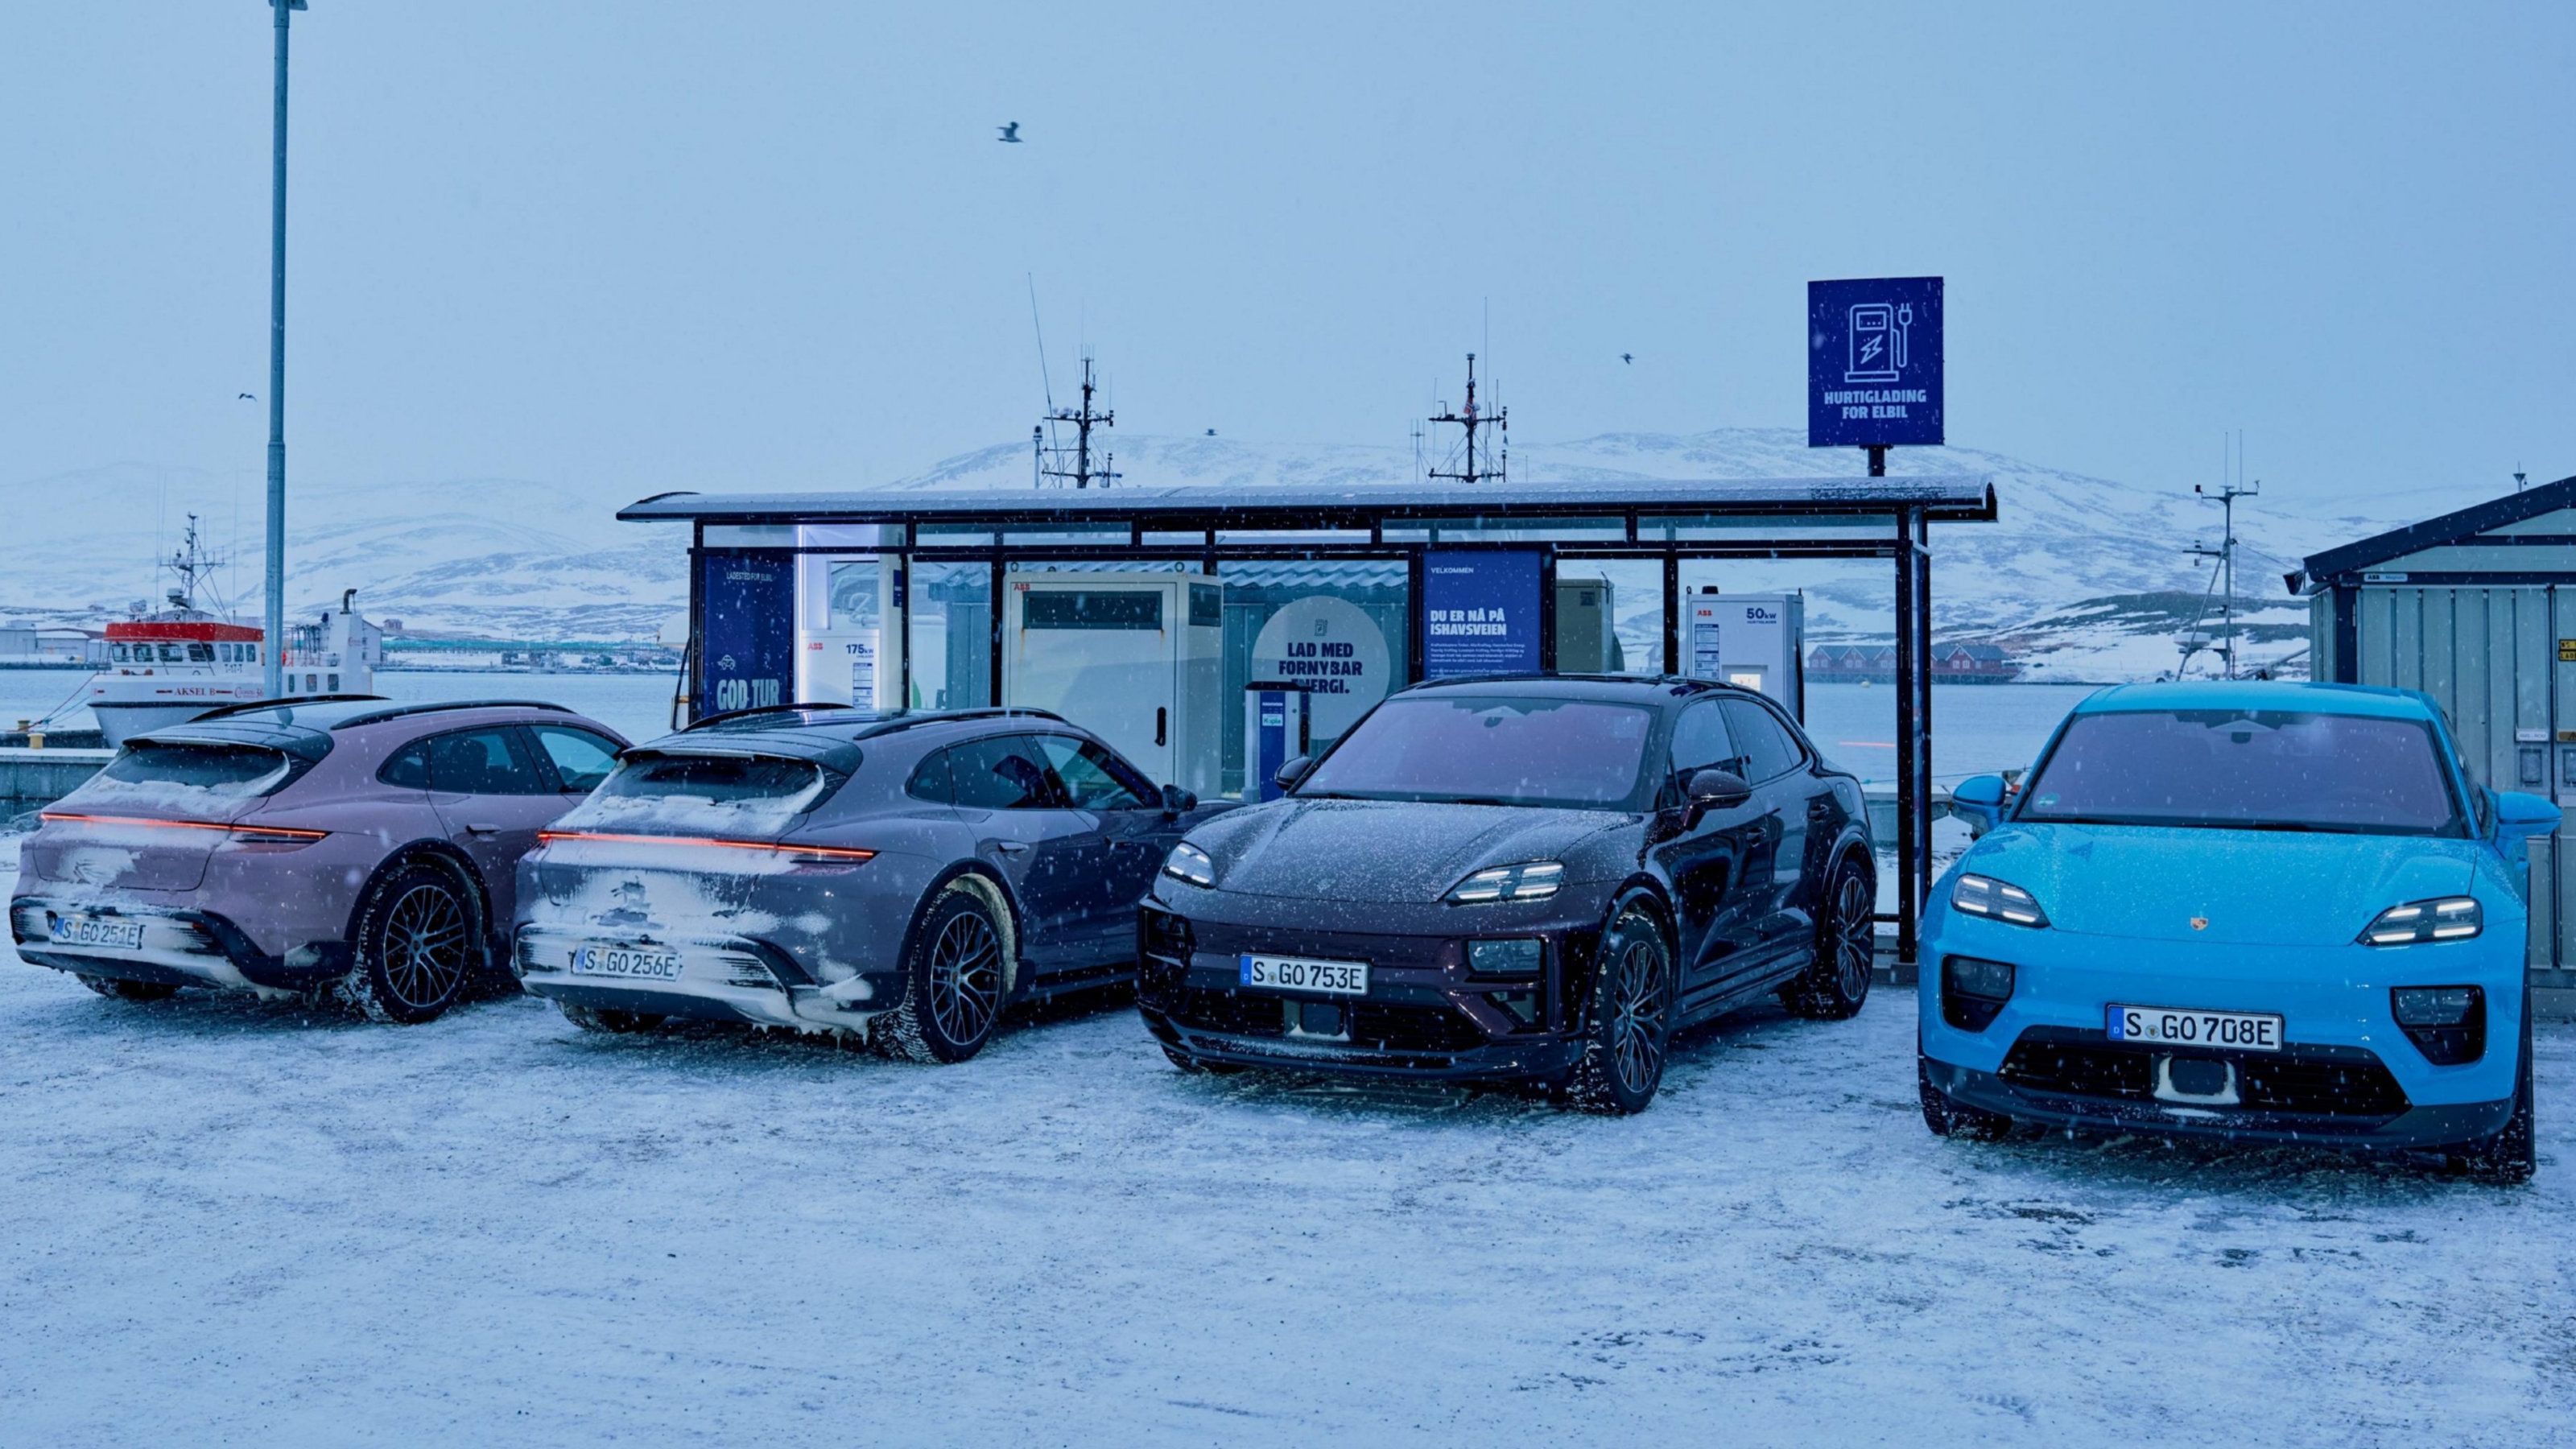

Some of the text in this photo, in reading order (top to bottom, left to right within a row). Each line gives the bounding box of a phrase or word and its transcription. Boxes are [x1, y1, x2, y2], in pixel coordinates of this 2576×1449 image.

[1824, 389, 1926, 405] HURTIGLADING
[1842, 405, 1908, 419] FOR ELBIL
[726, 571, 750, 580] LADESTED
[750, 572, 760, 581] FOR
[1013, 583, 1030, 591] ABB
[1430, 607, 1505, 621] DU ER NÅ PÅ
[1746, 607, 1777, 619] 50kW
[1430, 623, 1507, 635] ISHAVSVEIEN
[807, 642, 824, 650] ABB
[845, 643, 874, 654] 175kW
[1287, 642, 1354, 658] LAD MED
[1278, 660, 1363, 675] FORNYBAR
[174, 688, 208, 696] AKSEL
[1291, 679, 1350, 694] NERGI.
[716, 679, 780, 710] GOD TUR
[63, 922, 138, 946] S GO 251E
[584, 950, 675, 976] S GO 256E
[1253, 961, 1265, 982] S
[1279, 963, 1305, 985] GO
[1310, 965, 1363, 990] 753E
[2125, 1013, 2141, 1037] S
[2162, 1015, 2197, 1040] GO
[2203, 1017, 2274, 1046] 708E
